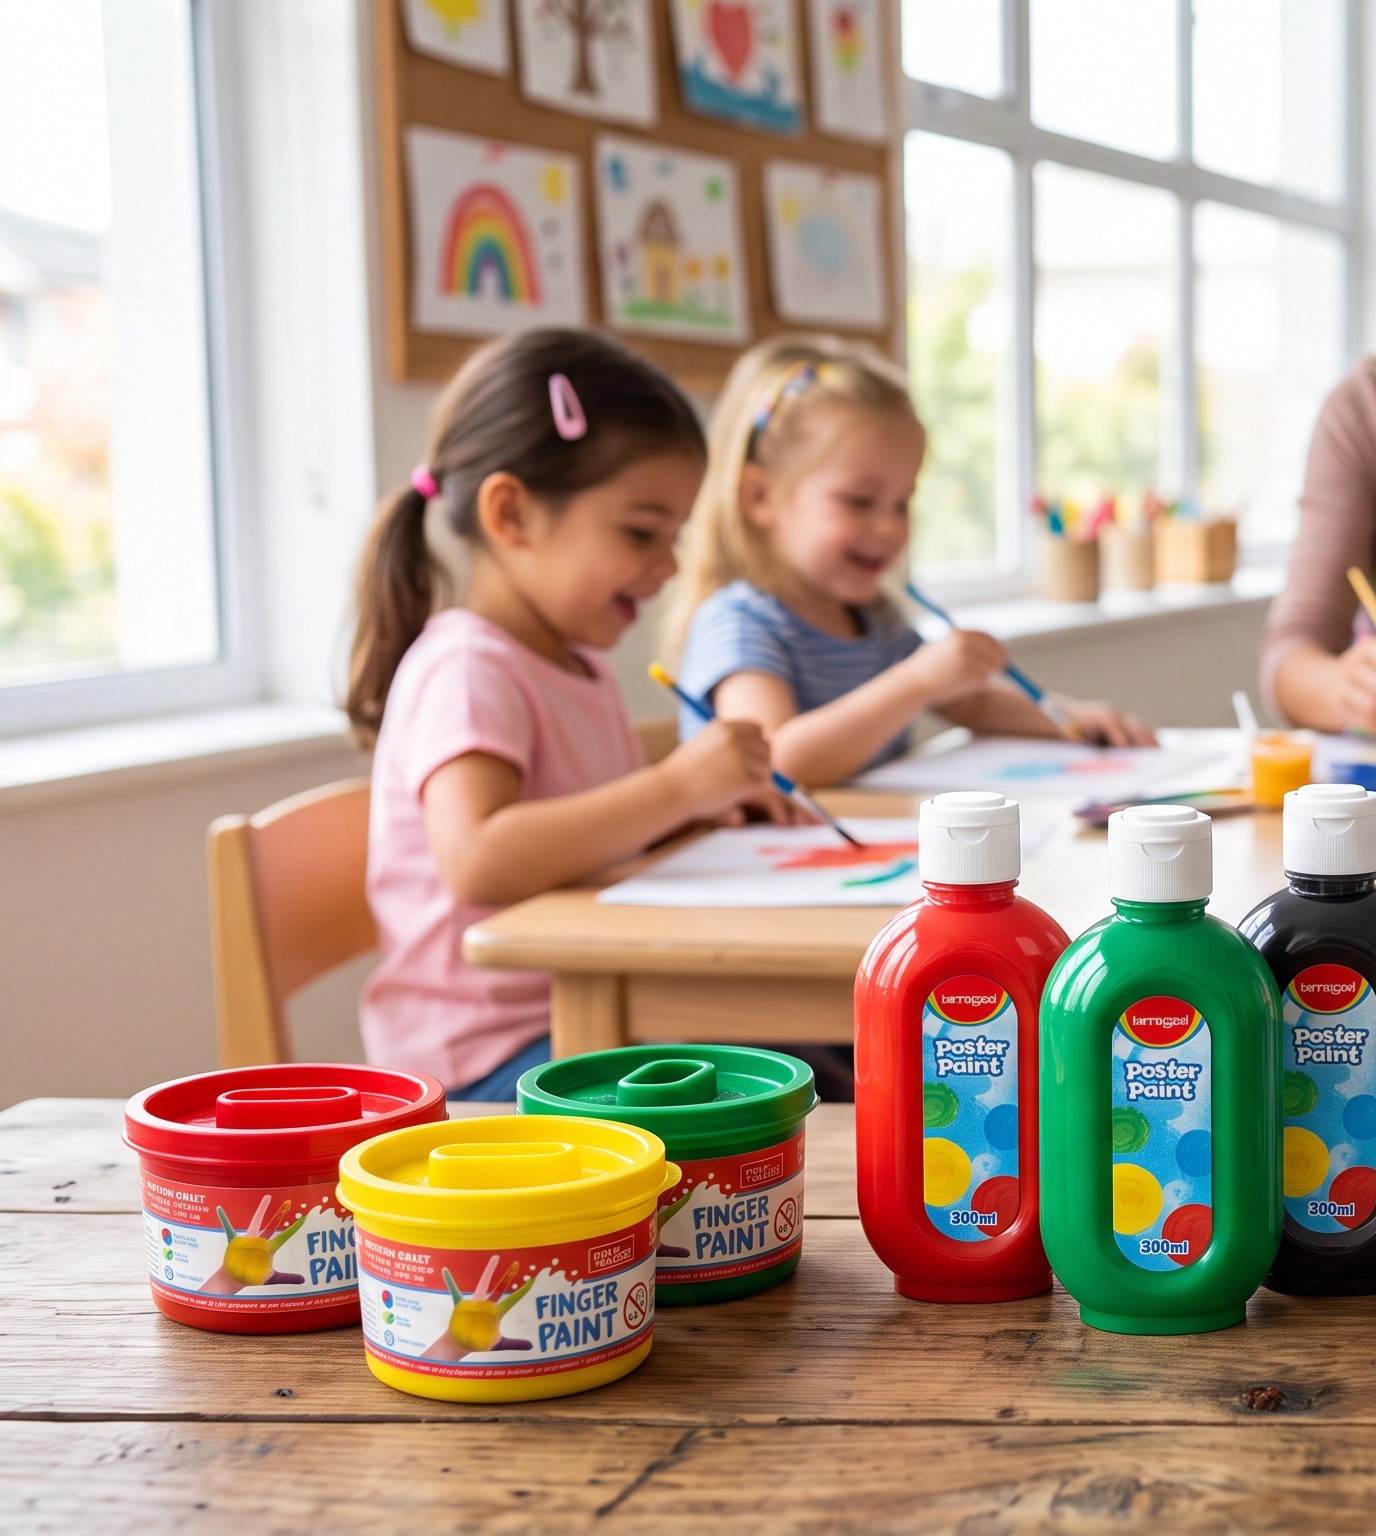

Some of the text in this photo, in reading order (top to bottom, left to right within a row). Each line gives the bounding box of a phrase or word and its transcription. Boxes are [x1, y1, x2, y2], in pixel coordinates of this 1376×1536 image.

[1294, 1026, 1368, 1045] Poster
[934, 1037, 1009, 1057] Poster
[1296, 1045, 1362, 1065] Paint
[936, 1057, 1004, 1077] Paint
[1125, 1059, 1201, 1081] Poster
[1128, 1081, 1196, 1101] Paint
[693, 1195, 769, 1229] FINGER
[1308, 1201, 1354, 1216] 300ml
[695, 1220, 769, 1260] PAINT
[1140, 1239, 1189, 1254] 300ml
[535, 1281, 618, 1319] FINGER
[538, 1308, 617, 1352] PAINT
